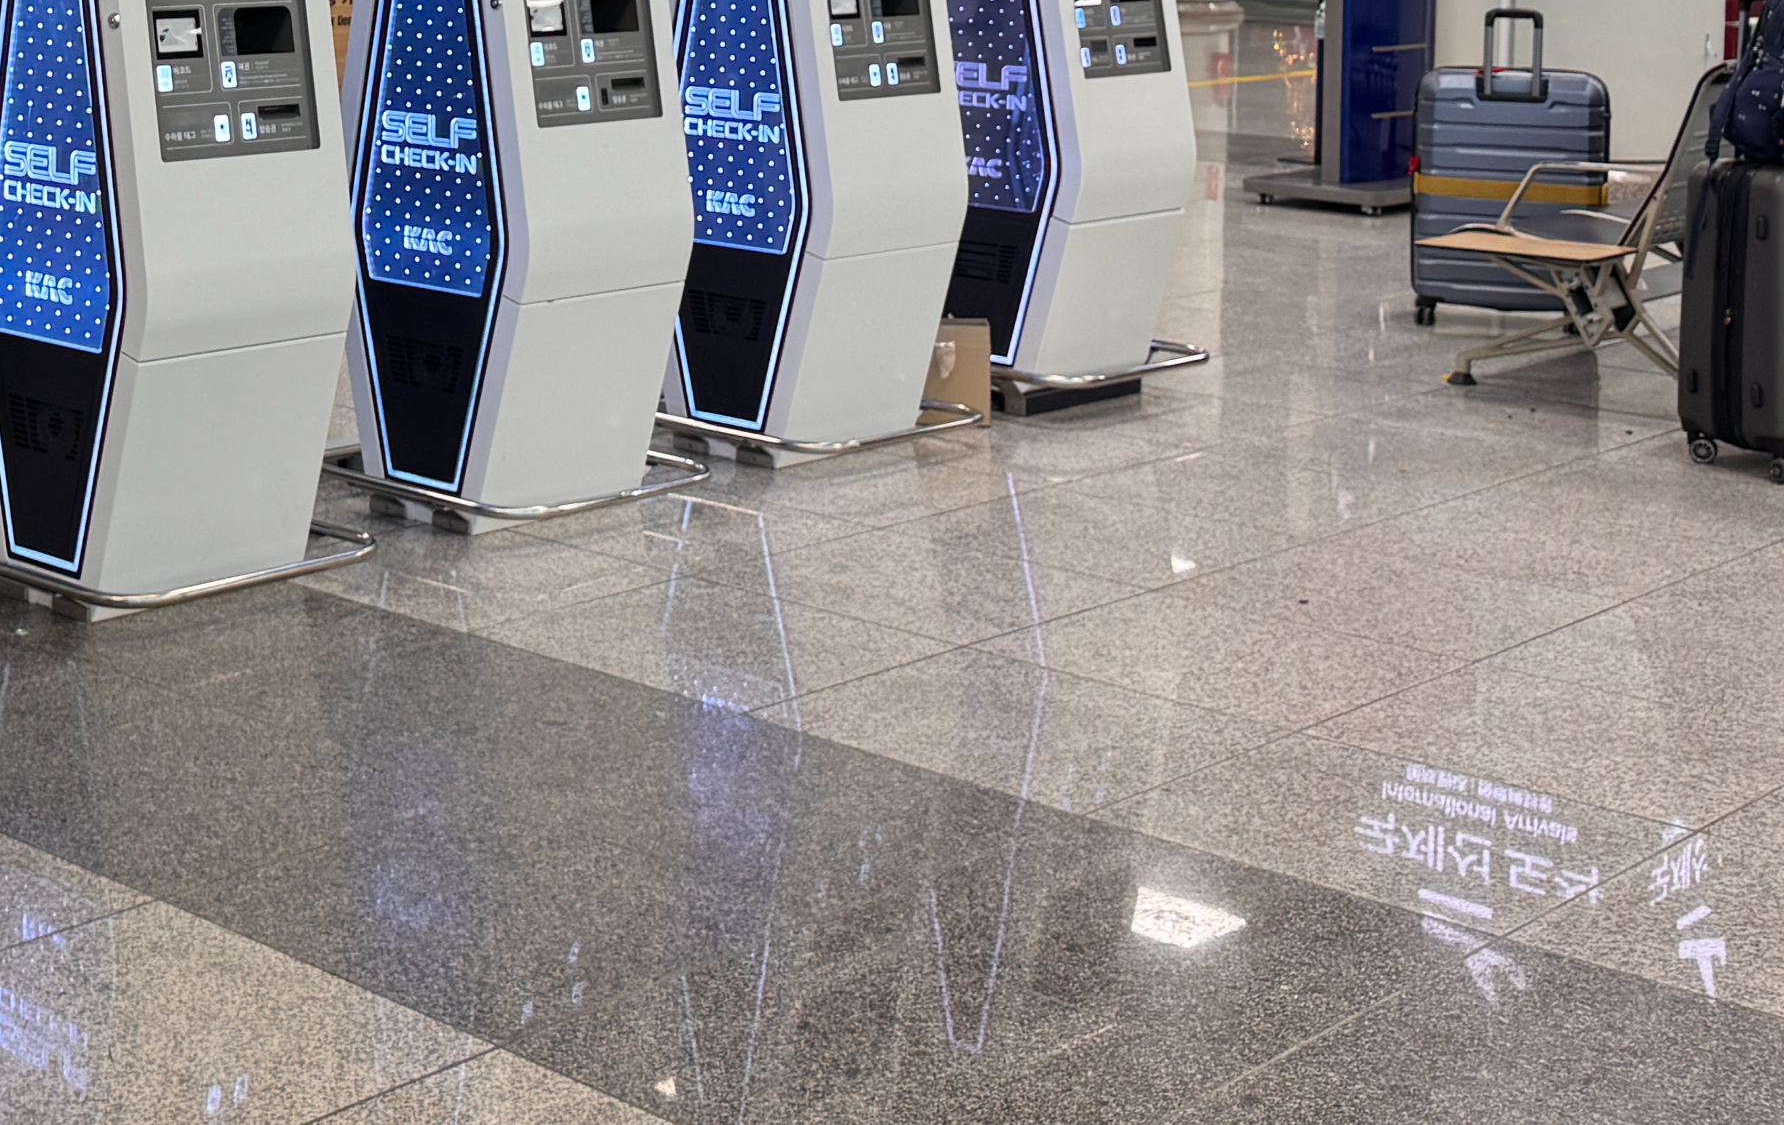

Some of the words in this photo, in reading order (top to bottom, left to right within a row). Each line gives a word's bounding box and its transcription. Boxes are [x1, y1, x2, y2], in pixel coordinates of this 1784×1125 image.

[685, 85, 780, 121] SELF
[382, 110, 477, 149] SELF
[684, 117, 780, 144] CHECK-IN
[4, 140, 97, 185] SELF
[381, 144, 477, 175] CHECK-IN
[3, 179, 96, 214] CHECK-IN
[706, 189, 755, 217] KAC
[403, 225, 453, 255] KAC
[26, 270, 73, 305] KAC
